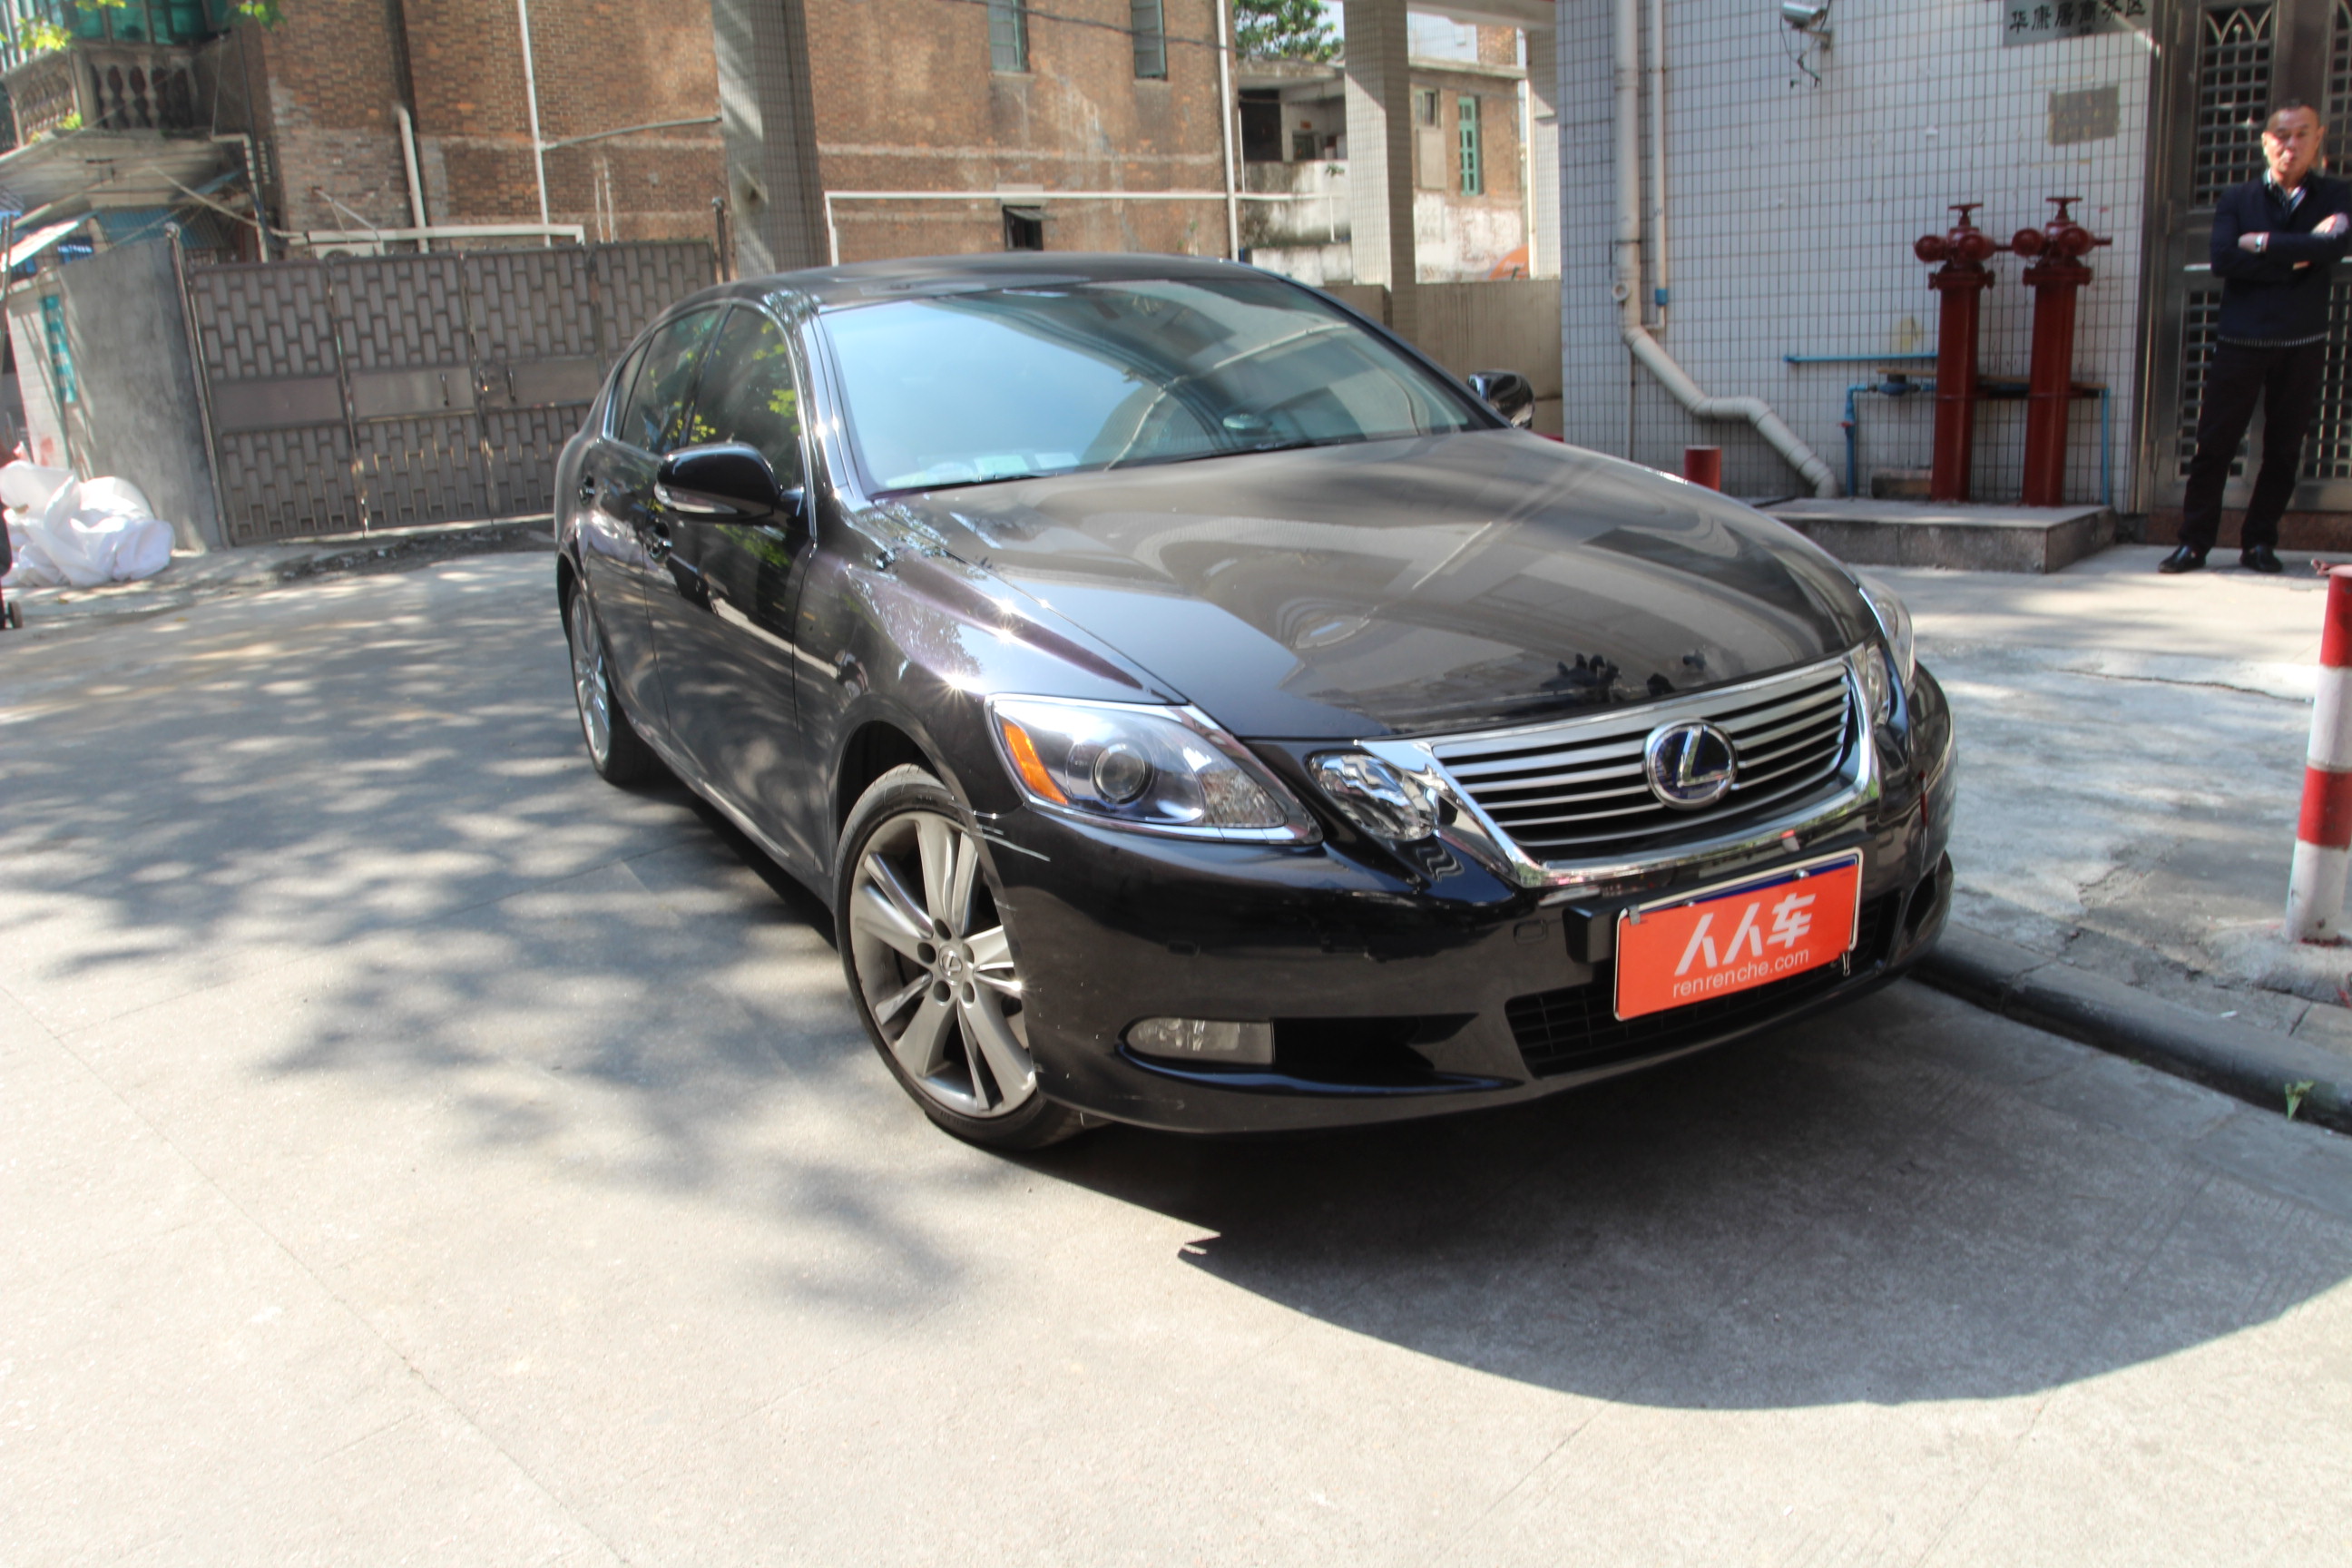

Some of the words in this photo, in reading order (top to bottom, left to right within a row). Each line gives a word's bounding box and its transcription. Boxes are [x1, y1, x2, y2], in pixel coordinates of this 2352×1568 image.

[1674, 892, 1816, 976] 人人车
[1672, 949, 1809, 999] renrenche.com
